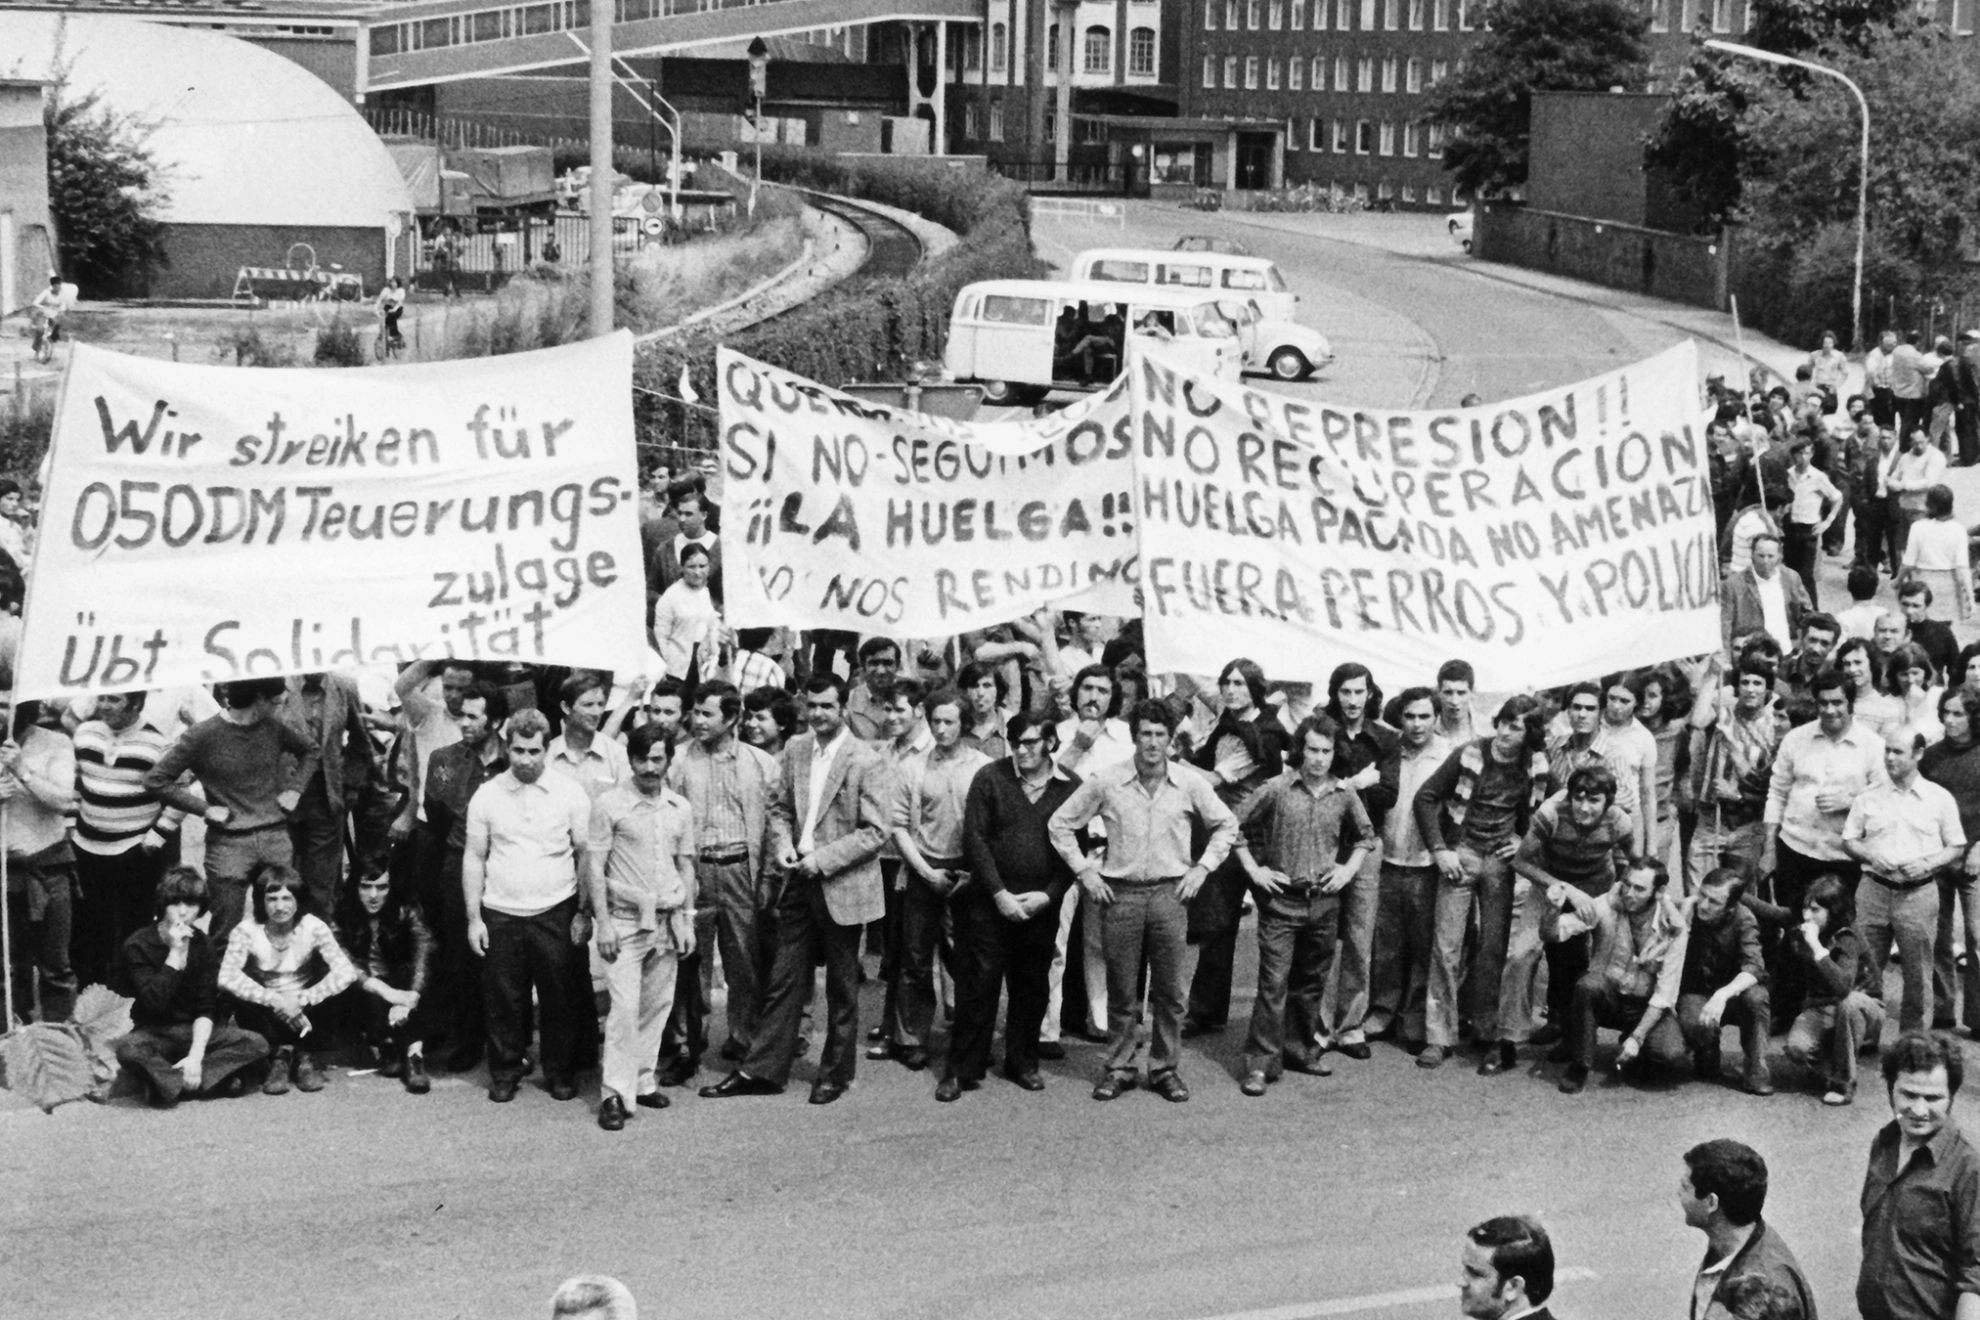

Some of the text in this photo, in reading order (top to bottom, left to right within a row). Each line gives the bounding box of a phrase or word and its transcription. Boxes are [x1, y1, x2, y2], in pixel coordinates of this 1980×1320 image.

[1142, 356, 1223, 418] NO
[94, 395, 574, 467] Wir streiken für
[726, 412, 776, 483] SI
[1143, 410, 1220, 475] NO
[1142, 475, 1302, 547] HUELGA
[1487, 524, 1541, 567] NO
[428, 543, 619, 609] zulage
[819, 573, 909, 624] NOS
[1149, 557, 1303, 622] FUERA
[1319, 567, 1525, 646] PERROS
[1538, 568, 1573, 624] Y
[59, 611, 168, 688] Übt
